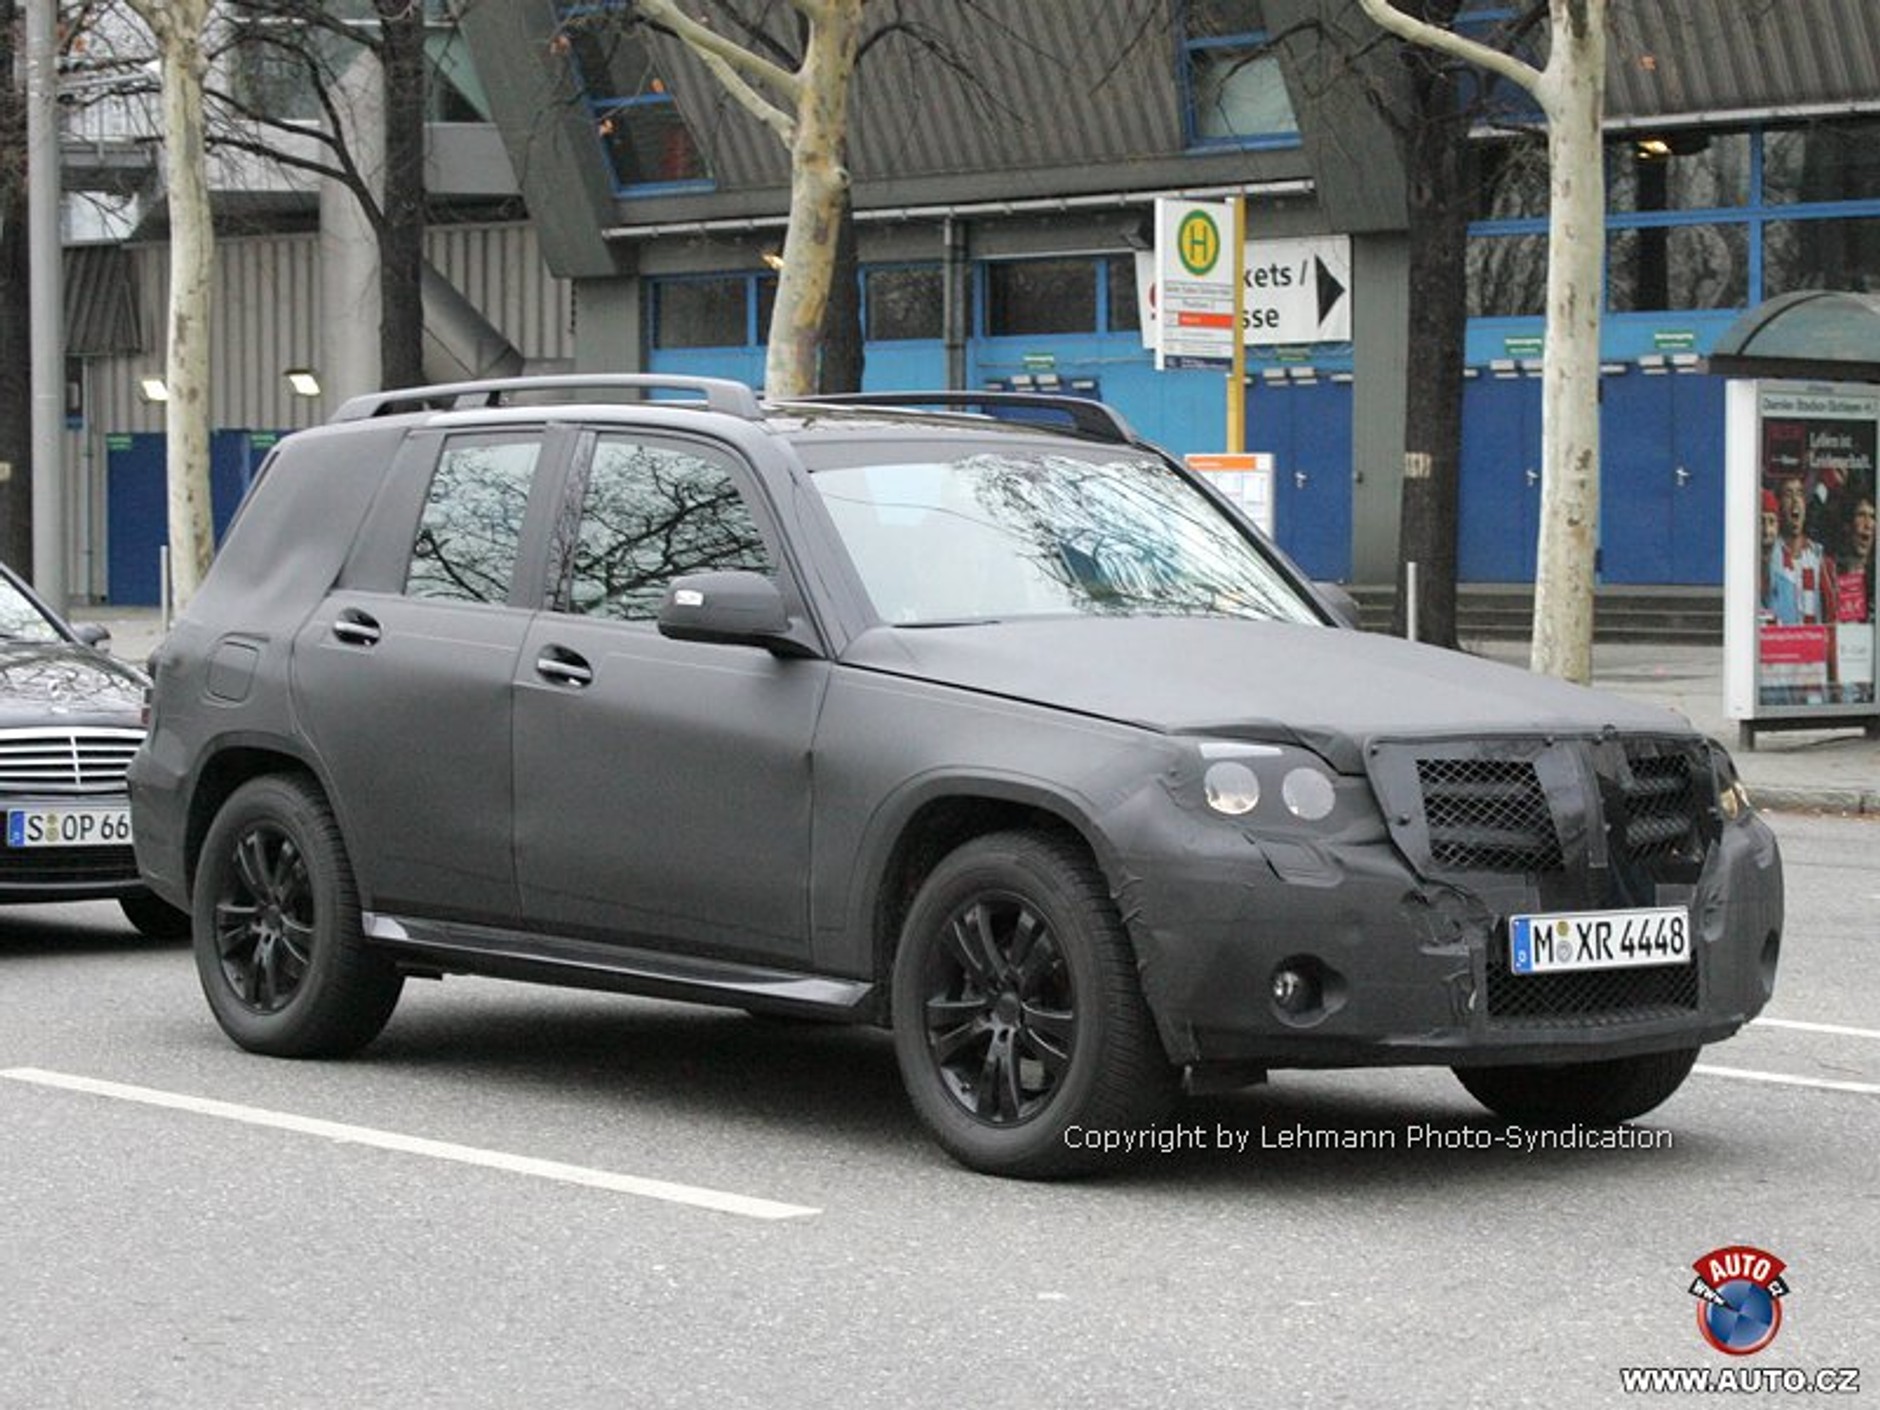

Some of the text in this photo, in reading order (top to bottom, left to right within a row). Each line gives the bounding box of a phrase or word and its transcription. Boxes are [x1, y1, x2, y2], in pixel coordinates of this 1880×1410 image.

[1190, 225, 1207, 261] H
[27, 813, 129, 841] S OP 66
[1533, 924, 1555, 964] M
[1576, 920, 1614, 962] XR
[1620, 916, 1685, 958] 4448
